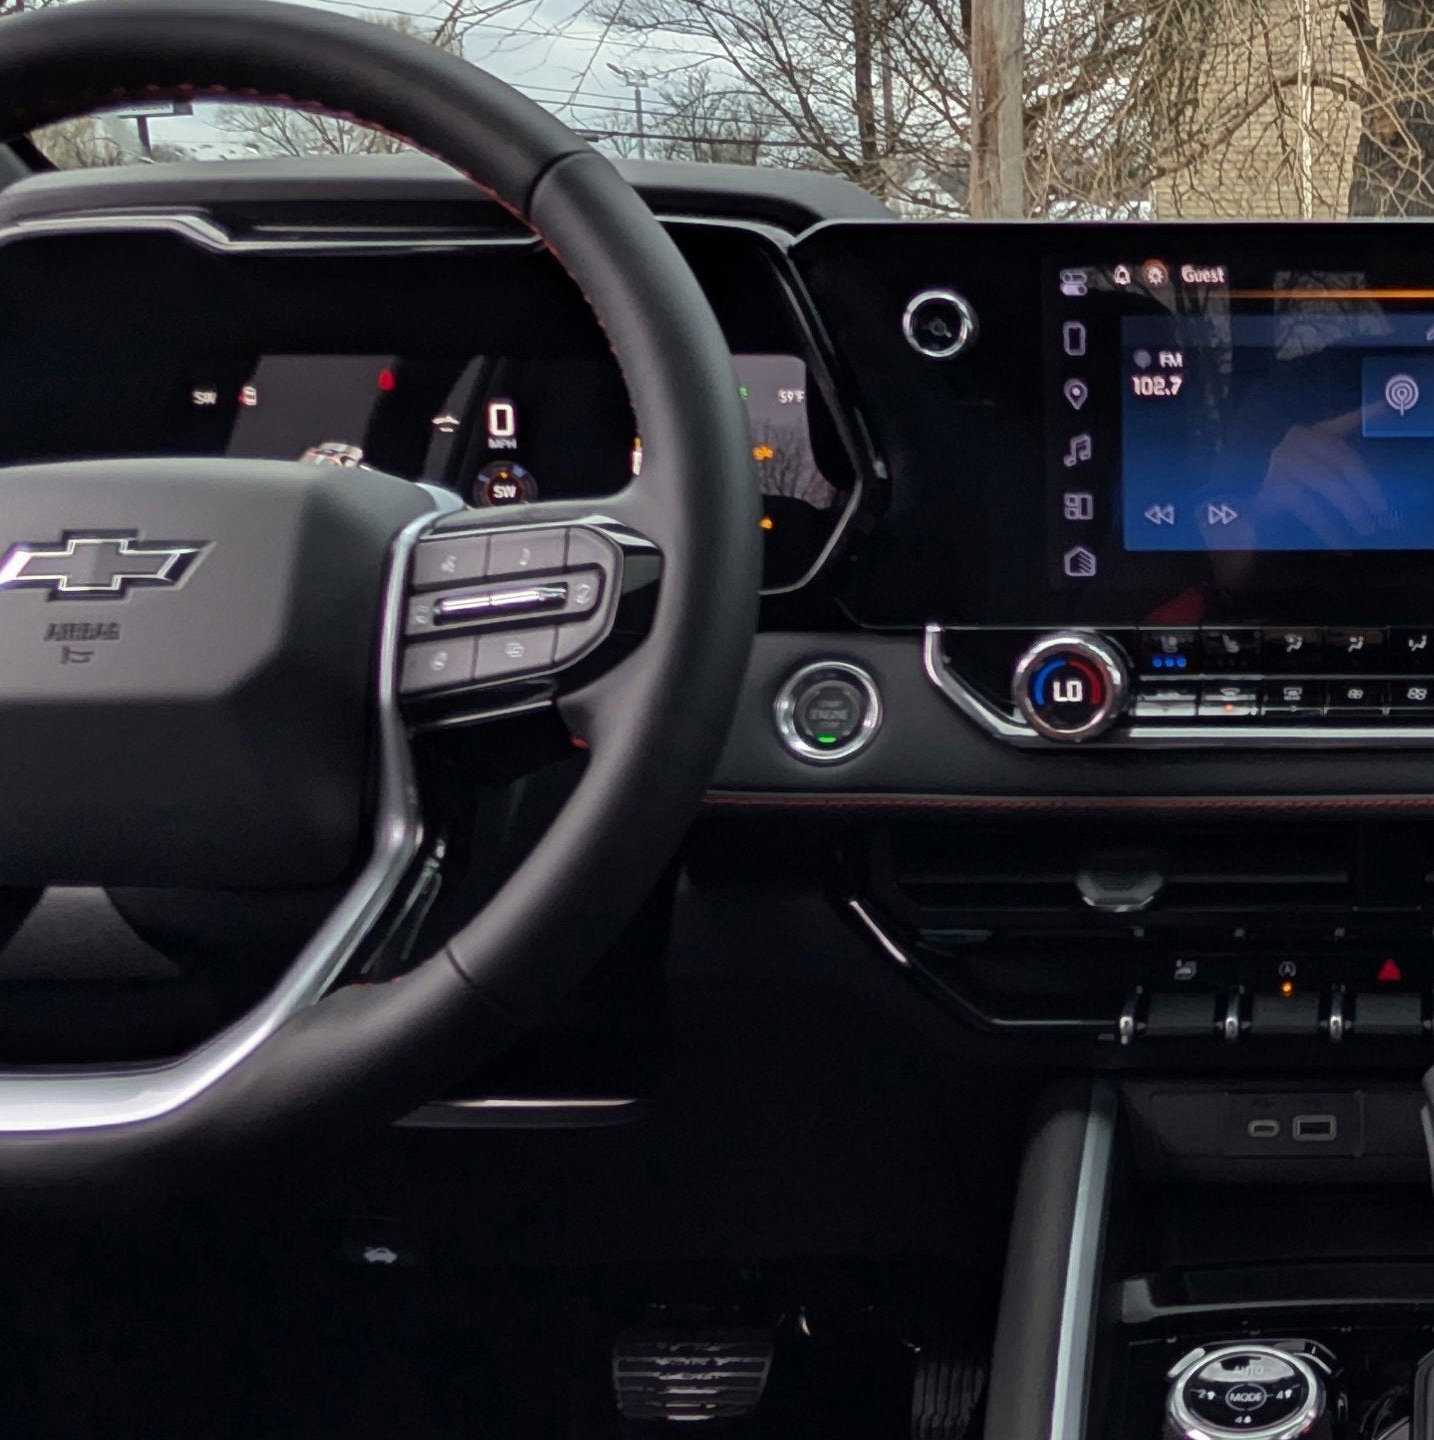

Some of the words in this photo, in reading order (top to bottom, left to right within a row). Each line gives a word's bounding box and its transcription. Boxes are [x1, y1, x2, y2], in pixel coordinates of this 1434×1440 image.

[1181, 265, 1226, 283] Guest
[1158, 351, 1183, 367] FM
[1132, 376, 1183, 396] 102.7
[192, 390, 217, 405] SW
[489, 403, 515, 436] 0
[488, 438, 517, 449] MPH
[492, 485, 517, 499] SW
[44, 622, 121, 641] AIRBAG
[1053, 680, 1083, 702] LO
[1229, 1392, 1263, 1402] MODE
